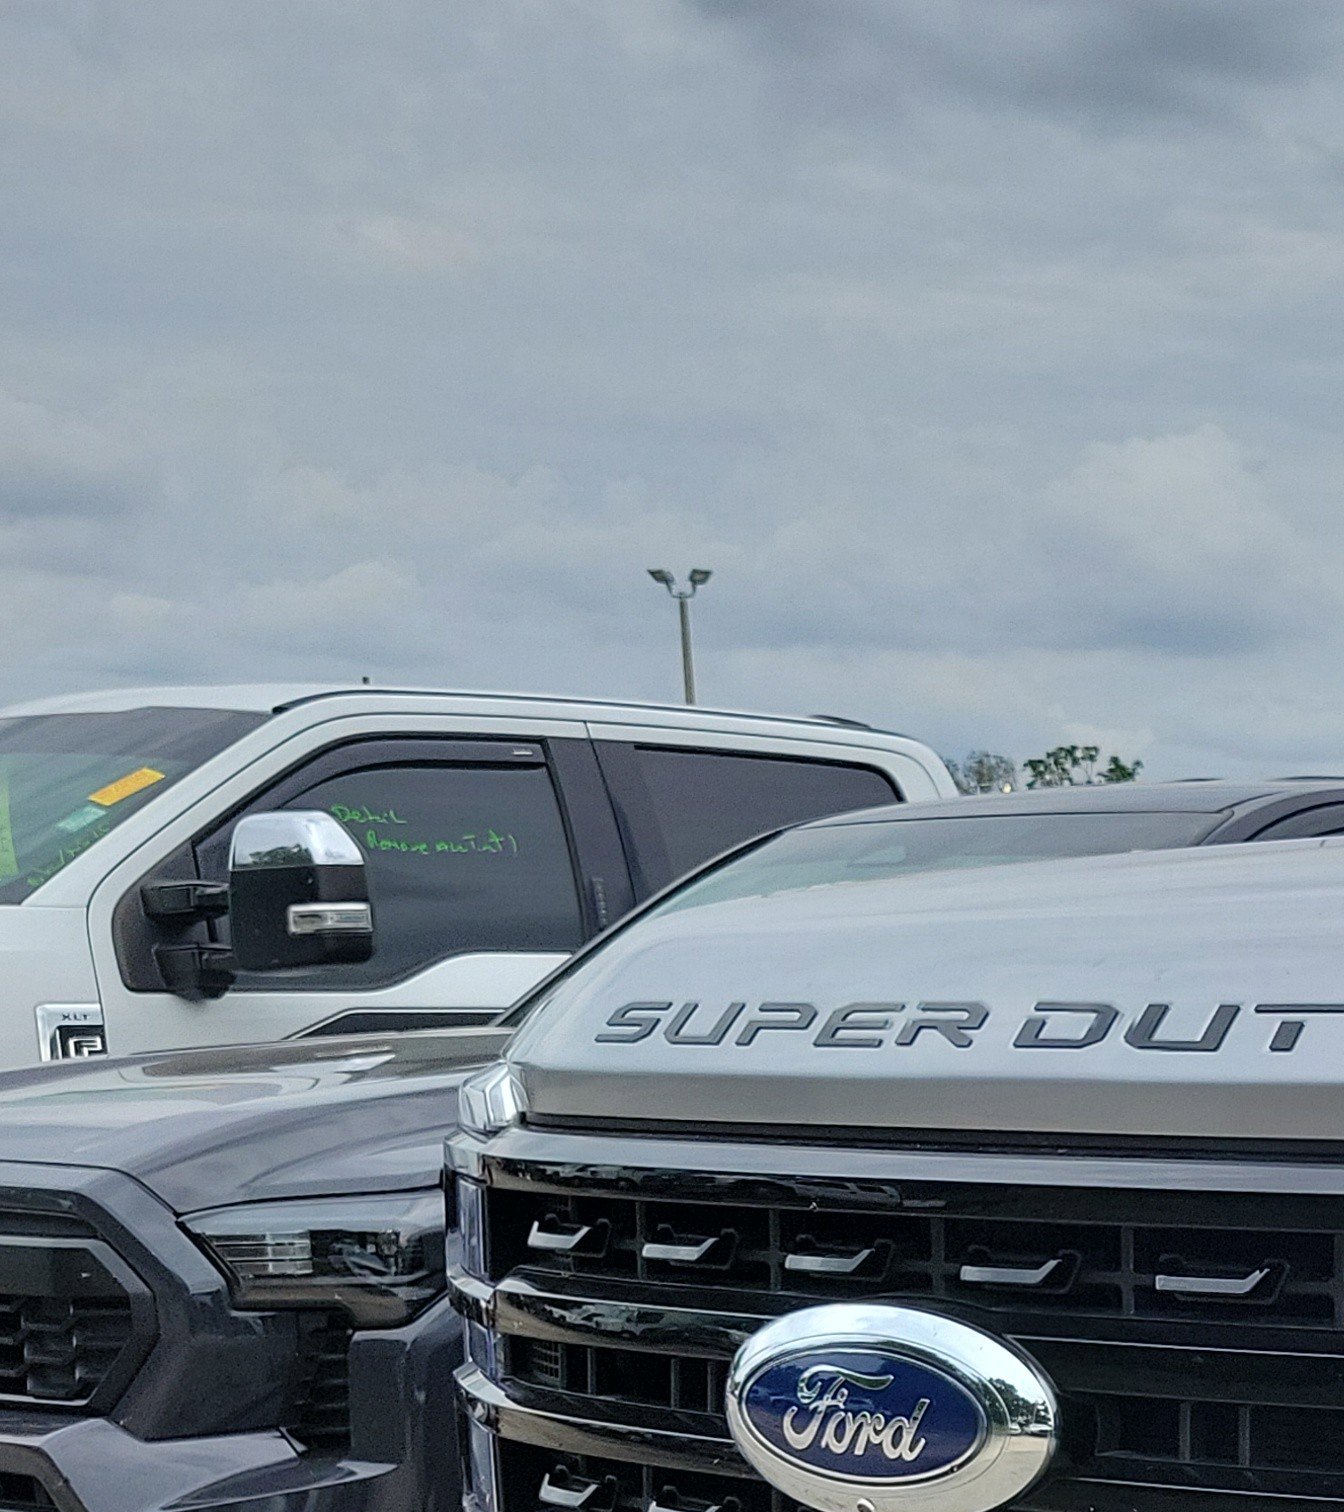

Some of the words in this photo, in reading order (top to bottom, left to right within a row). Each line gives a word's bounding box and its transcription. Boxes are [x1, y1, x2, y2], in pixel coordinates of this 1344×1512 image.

[62, 1013, 88, 1021] XLT
[594, 1001, 990, 1049] SUPER
[782, 1364, 930, 1461] Ford
